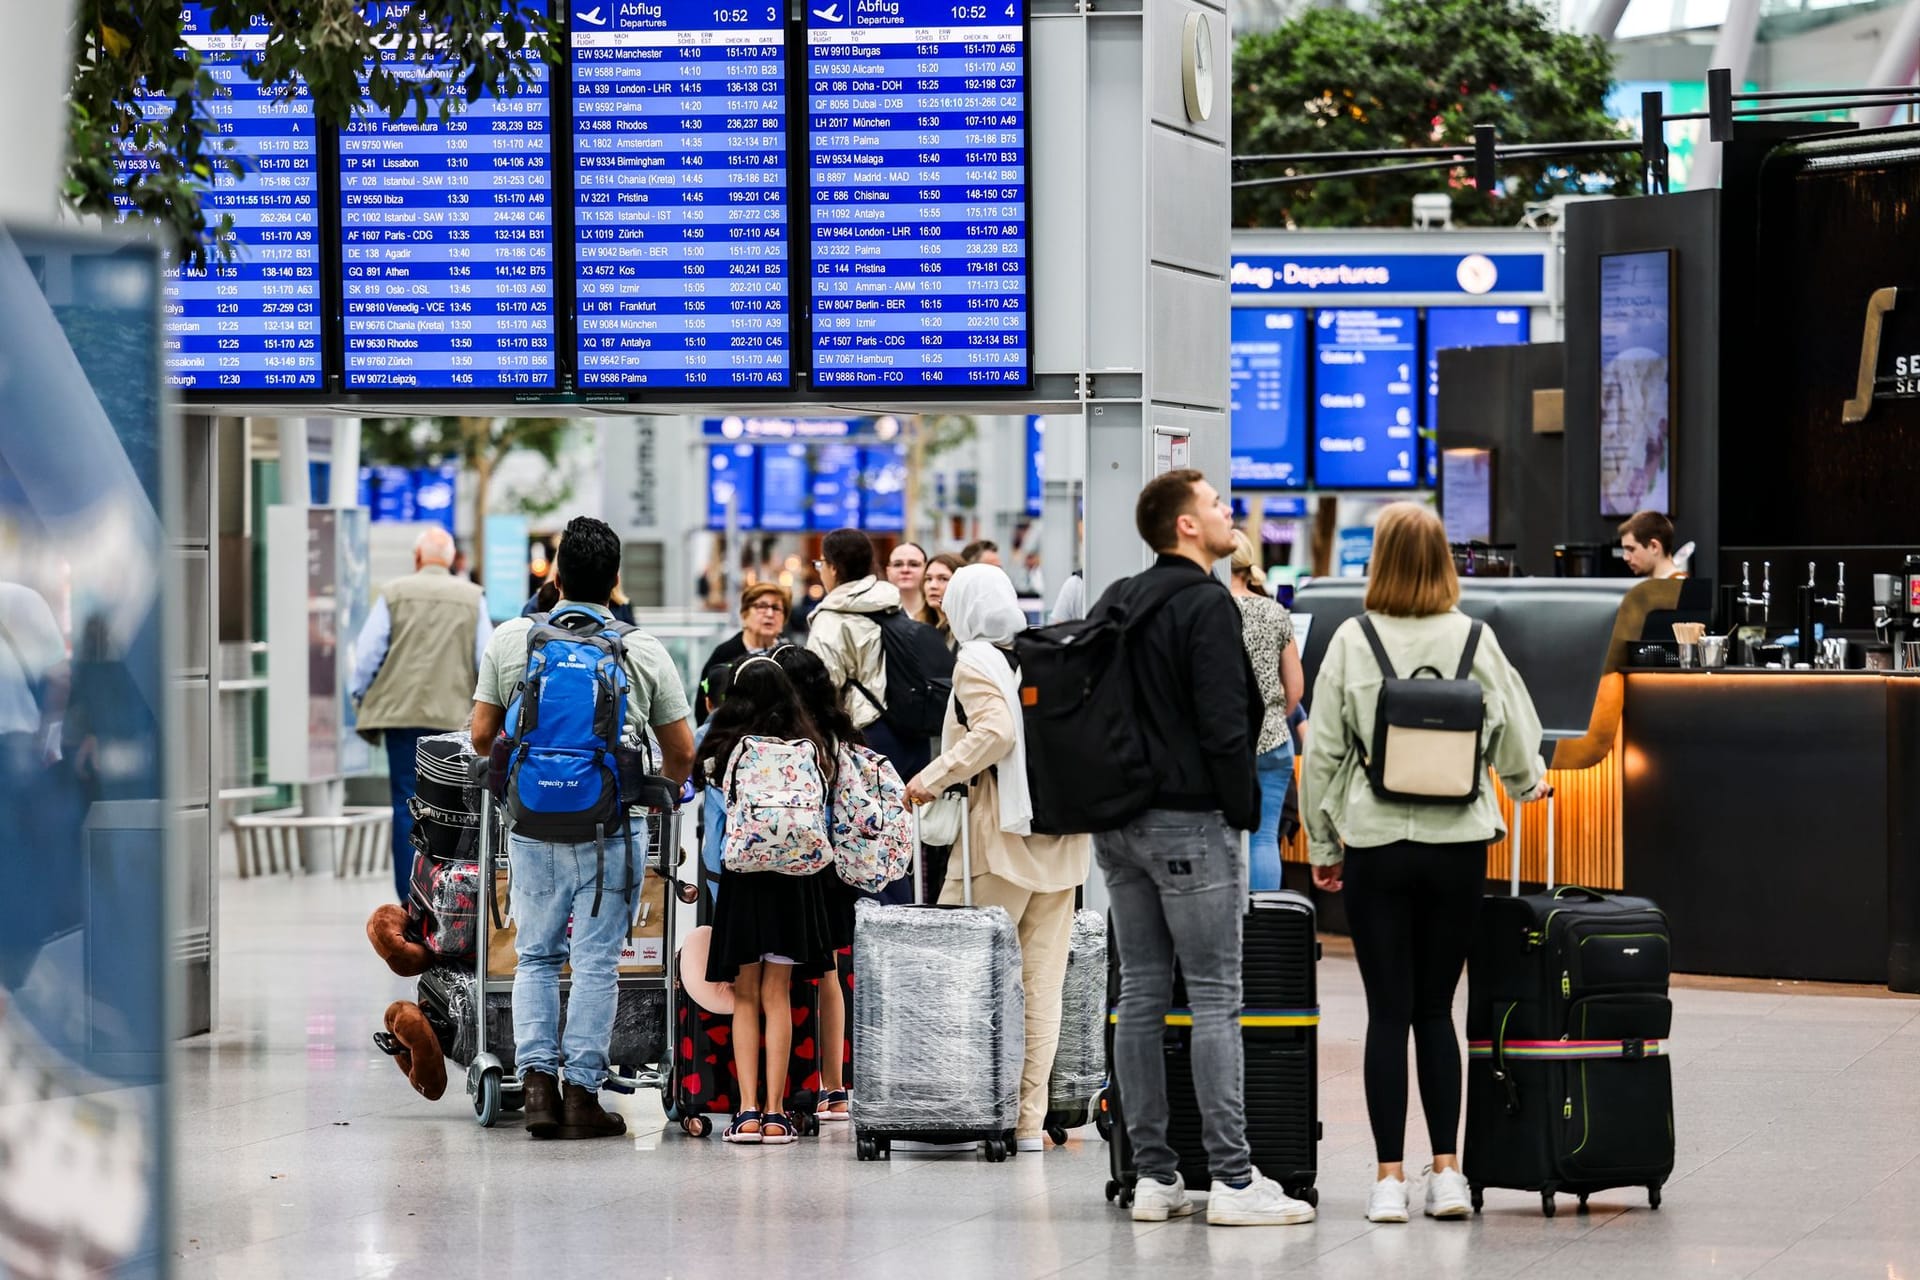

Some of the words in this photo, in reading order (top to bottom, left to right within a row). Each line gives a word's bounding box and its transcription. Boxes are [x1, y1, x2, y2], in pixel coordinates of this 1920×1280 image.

[619, 4, 662, 18] Abflug
[857, 0, 899, 14] Abflug
[951, 6, 986, 19] 10:52
[1004, 4, 1015, 18] 4
[713, 10, 748, 22] 10:52
[766, 8, 776, 22] 3
[857, 16, 905, 25] Departures
[620, 19, 667, 28] Departures
[578, 50, 594, 58] EW
[595, 50, 614, 58] 9342
[616, 50, 662, 58] Manchester
[680, 48, 700, 58] 14:10
[726, 48, 758, 56] 151-170
[762, 48, 776, 56] A79
[814, 46, 828, 56] EW
[831, 46, 850, 56] 9910
[852, 46, 880, 56] Burgas
[918, 46, 938, 54] 15:15
[964, 44, 996, 54] 151-170
[1000, 44, 1016, 52] A66
[580, 120, 590, 130] X3
[592, 120, 611, 130] 4588
[616, 120, 647, 130] Rhodos
[680, 120, 702, 128] 14:30
[728, 118, 758, 128] 236,237
[762, 118, 778, 128] B80
[346, 158, 358, 168] TP
[362, 158, 376, 168] 541
[384, 158, 418, 168] Lissabon
[446, 158, 468, 168] 13:10
[494, 158, 524, 166] 104-106
[528, 158, 544, 166] A39
[580, 158, 595, 166] EW
[596, 156, 615, 166] 9334
[618, 156, 664, 168] Birmingham
[682, 156, 702, 166] 14:40
[728, 156, 760, 164] 151-170
[763, 154, 778, 164] A81
[816, 154, 830, 164] EW
[833, 154, 852, 164] 9534
[854, 154, 884, 166] Malaga
[918, 154, 940, 162] 15:40
[966, 152, 997, 162] 151-170
[1001, 152, 1016, 162] B33
[214, 196, 236, 204] 11:30
[236, 196, 258, 204] 11:55
[260, 194, 291, 204] 151-170
[295, 194, 310, 204] A50
[347, 194, 362, 204] EW
[363, 194, 382, 204] 9550
[384, 194, 404, 204] Ibiza
[448, 194, 468, 204] 13:30
[494, 194, 524, 204] 151-170
[528, 194, 544, 202] A49
[348, 230, 358, 240] AF
[362, 230, 380, 240] 1607
[384, 230, 406, 240] Paris
[412, 230, 432, 240] CDG
[448, 230, 470, 240] 13:35
[495, 230, 526, 240] 132-134
[530, 230, 544, 240] B31
[349, 266, 362, 276] GQ
[366, 266, 380, 276] 891
[386, 268, 409, 276] Athen
[450, 266, 470, 276] 13:45
[496, 266, 526, 276] 141,142
[530, 266, 546, 276] B75
[818, 264, 830, 274] DE
[835, 264, 848, 272] 144
[856, 264, 886, 274] Pristina
[920, 262, 941, 272] 16:05
[968, 262, 998, 272] 179-181
[1002, 262, 1018, 272] C53
[1284, 264, 1389, 288] Departures
[218, 304, 238, 312] 12:10
[262, 304, 294, 312] 257-259
[298, 304, 312, 312] C31
[583, 302, 594, 312] LH
[598, 302, 612, 312] 081
[620, 302, 656, 310] Frankfurt
[684, 300, 705, 310] 15:05
[730, 300, 762, 310] 107-110
[766, 300, 781, 310] A26
[818, 300, 834, 310] EW
[834, 300, 854, 310] 8047
[856, 300, 878, 310] Berlin
[886, 300, 905, 308] BER
[920, 300, 942, 308] 16:15
[968, 298, 998, 308] 151-170
[1003, 298, 1018, 308] A25
[218, 340, 239, 348] 12:25
[264, 338, 295, 348] 151-170
[298, 338, 314, 348] A25
[220, 374, 240, 384] 12:30
[266, 374, 296, 384] 151-170
[300, 374, 315, 384] A79
[584, 374, 598, 382] EW
[600, 374, 620, 382] 9586
[622, 374, 647, 382] Palma
[686, 372, 706, 382] 15:10
[732, 372, 762, 382] 151-170
[767, 372, 782, 382] A63
[820, 372, 834, 382] EW
[836, 372, 855, 382] 9886
[857, 372, 876, 382] Rom
[884, 372, 903, 382] FCO
[922, 372, 942, 380] 16:40
[968, 370, 1000, 380] 151-170
[1004, 370, 1019, 380] A65
